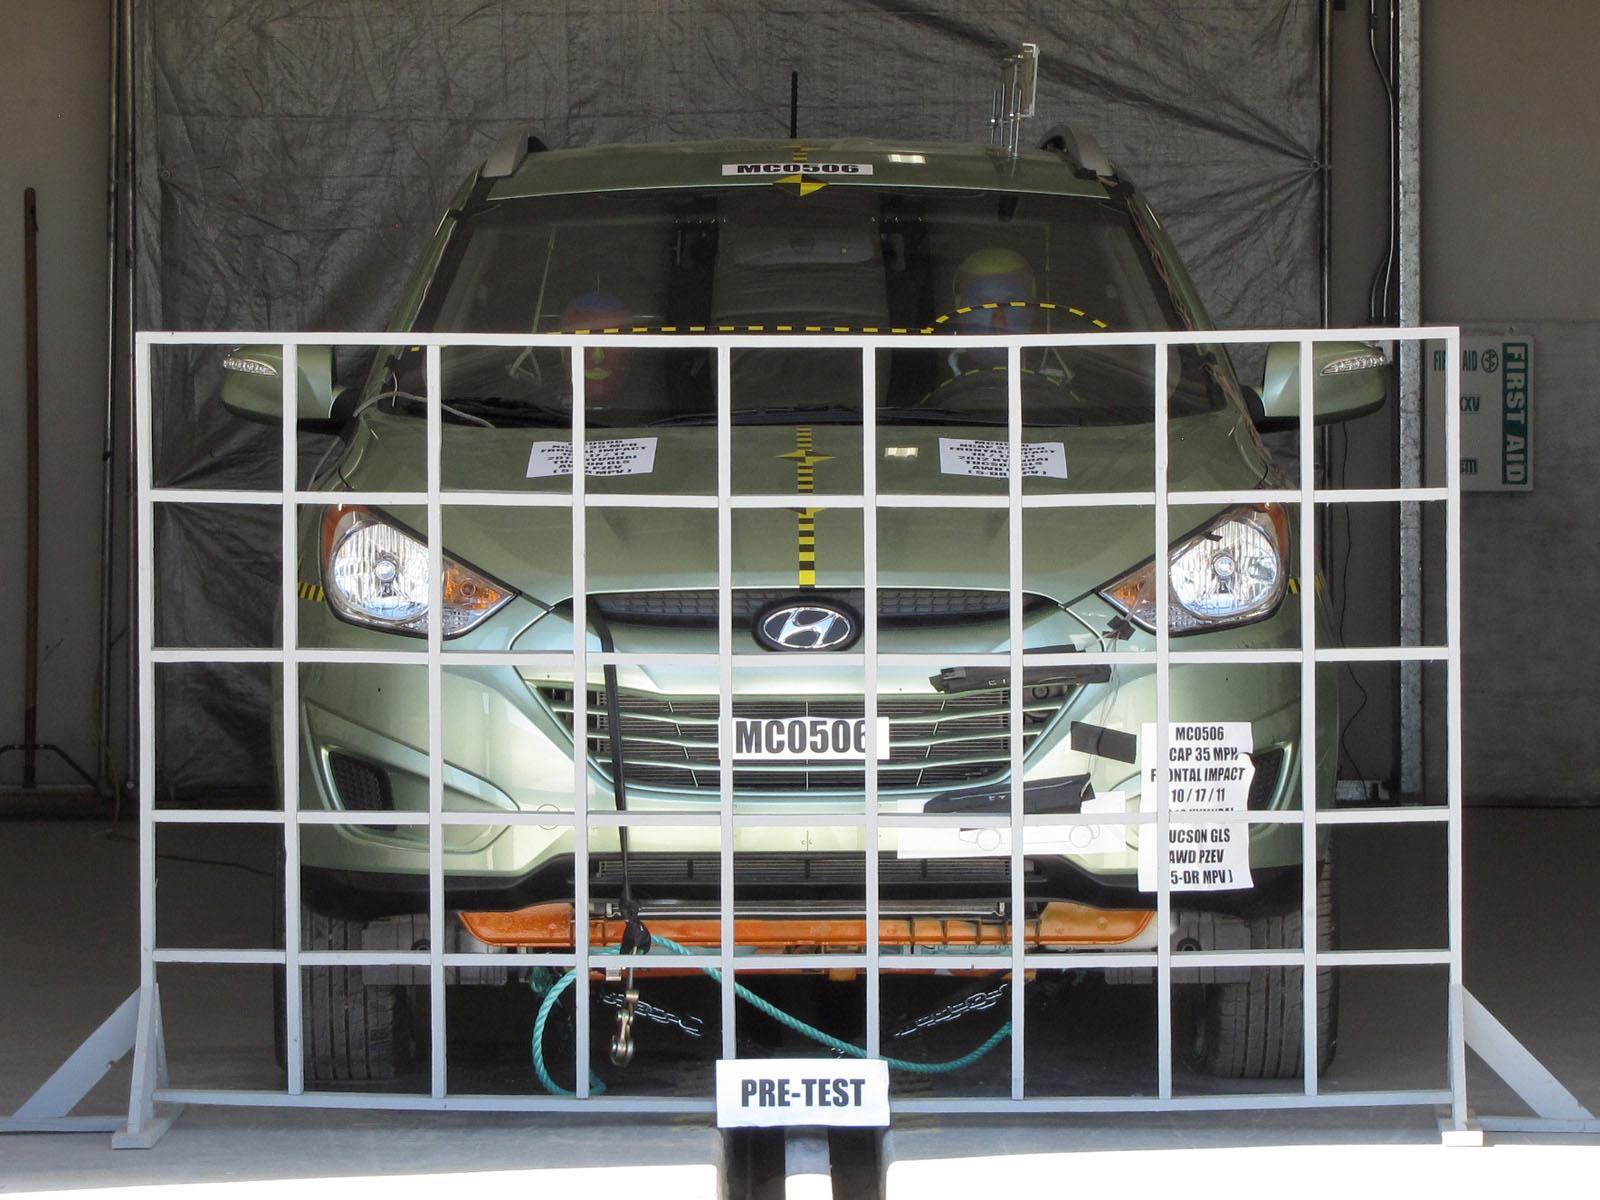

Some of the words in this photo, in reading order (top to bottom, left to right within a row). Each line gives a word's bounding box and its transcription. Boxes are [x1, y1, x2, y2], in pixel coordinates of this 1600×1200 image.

[737, 164, 859, 174] MC0506
[1462, 350, 1478, 371] AID
[1506, 346, 1526, 425] FIRST
[1506, 434, 1526, 482] AID
[735, 719, 866, 754] MC0506
[1175, 726, 1225, 741] MC0506
[1169, 747, 1191, 762] CAP
[1195, 747, 1211, 762] 35
[1213, 747, 1238, 761] MPH
[1151, 768, 1201, 783] FONTAL
[1204, 767, 1246, 782] IMPACT
[1169, 829, 1208, 844] UCSON
[1211, 828, 1231, 843] GLS
[1169, 850, 1196, 864] AWD
[1199, 849, 1225, 864] PZEV
[1203, 869, 1226, 884] MPV
[741, 1078, 866, 1108] PRE-TEST
